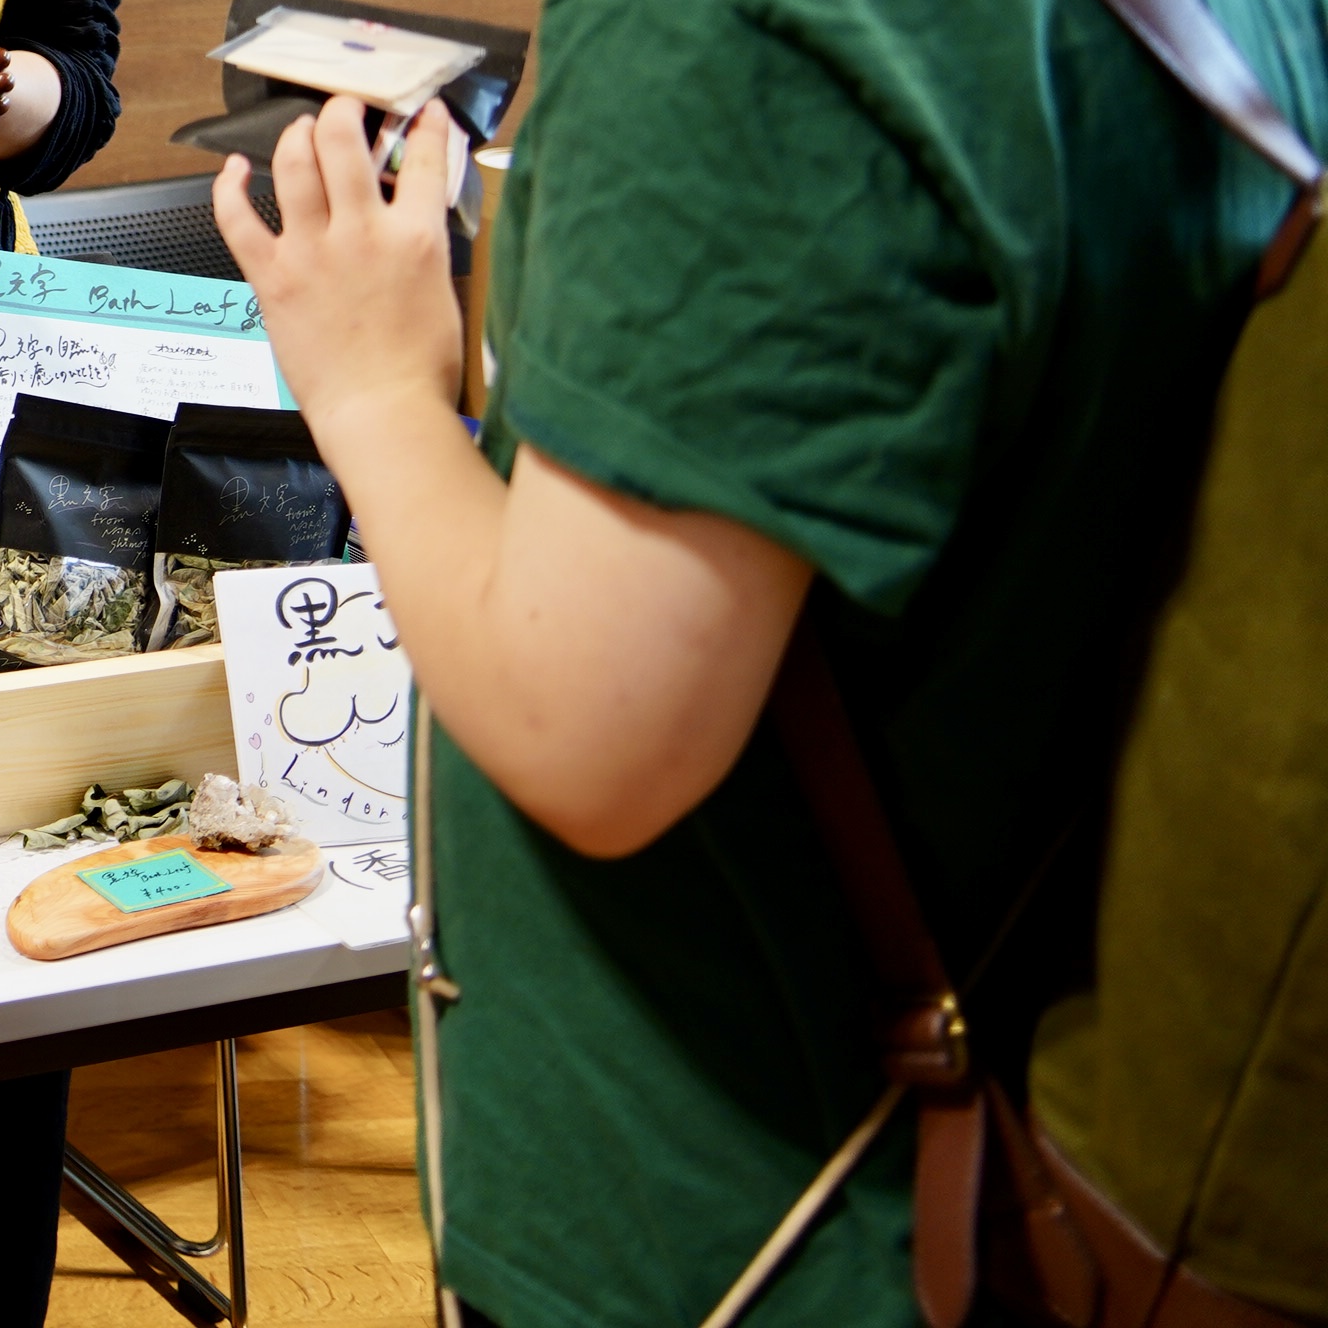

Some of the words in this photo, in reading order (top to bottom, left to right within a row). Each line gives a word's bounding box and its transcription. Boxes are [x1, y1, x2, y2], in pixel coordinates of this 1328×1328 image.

[89, 285, 161, 314] Bath
[165, 288, 239, 325] Leaf
[48, 475, 123, 511] 黒文字
[219, 476, 298, 526] 黒文字
[91, 514, 125, 526] from
